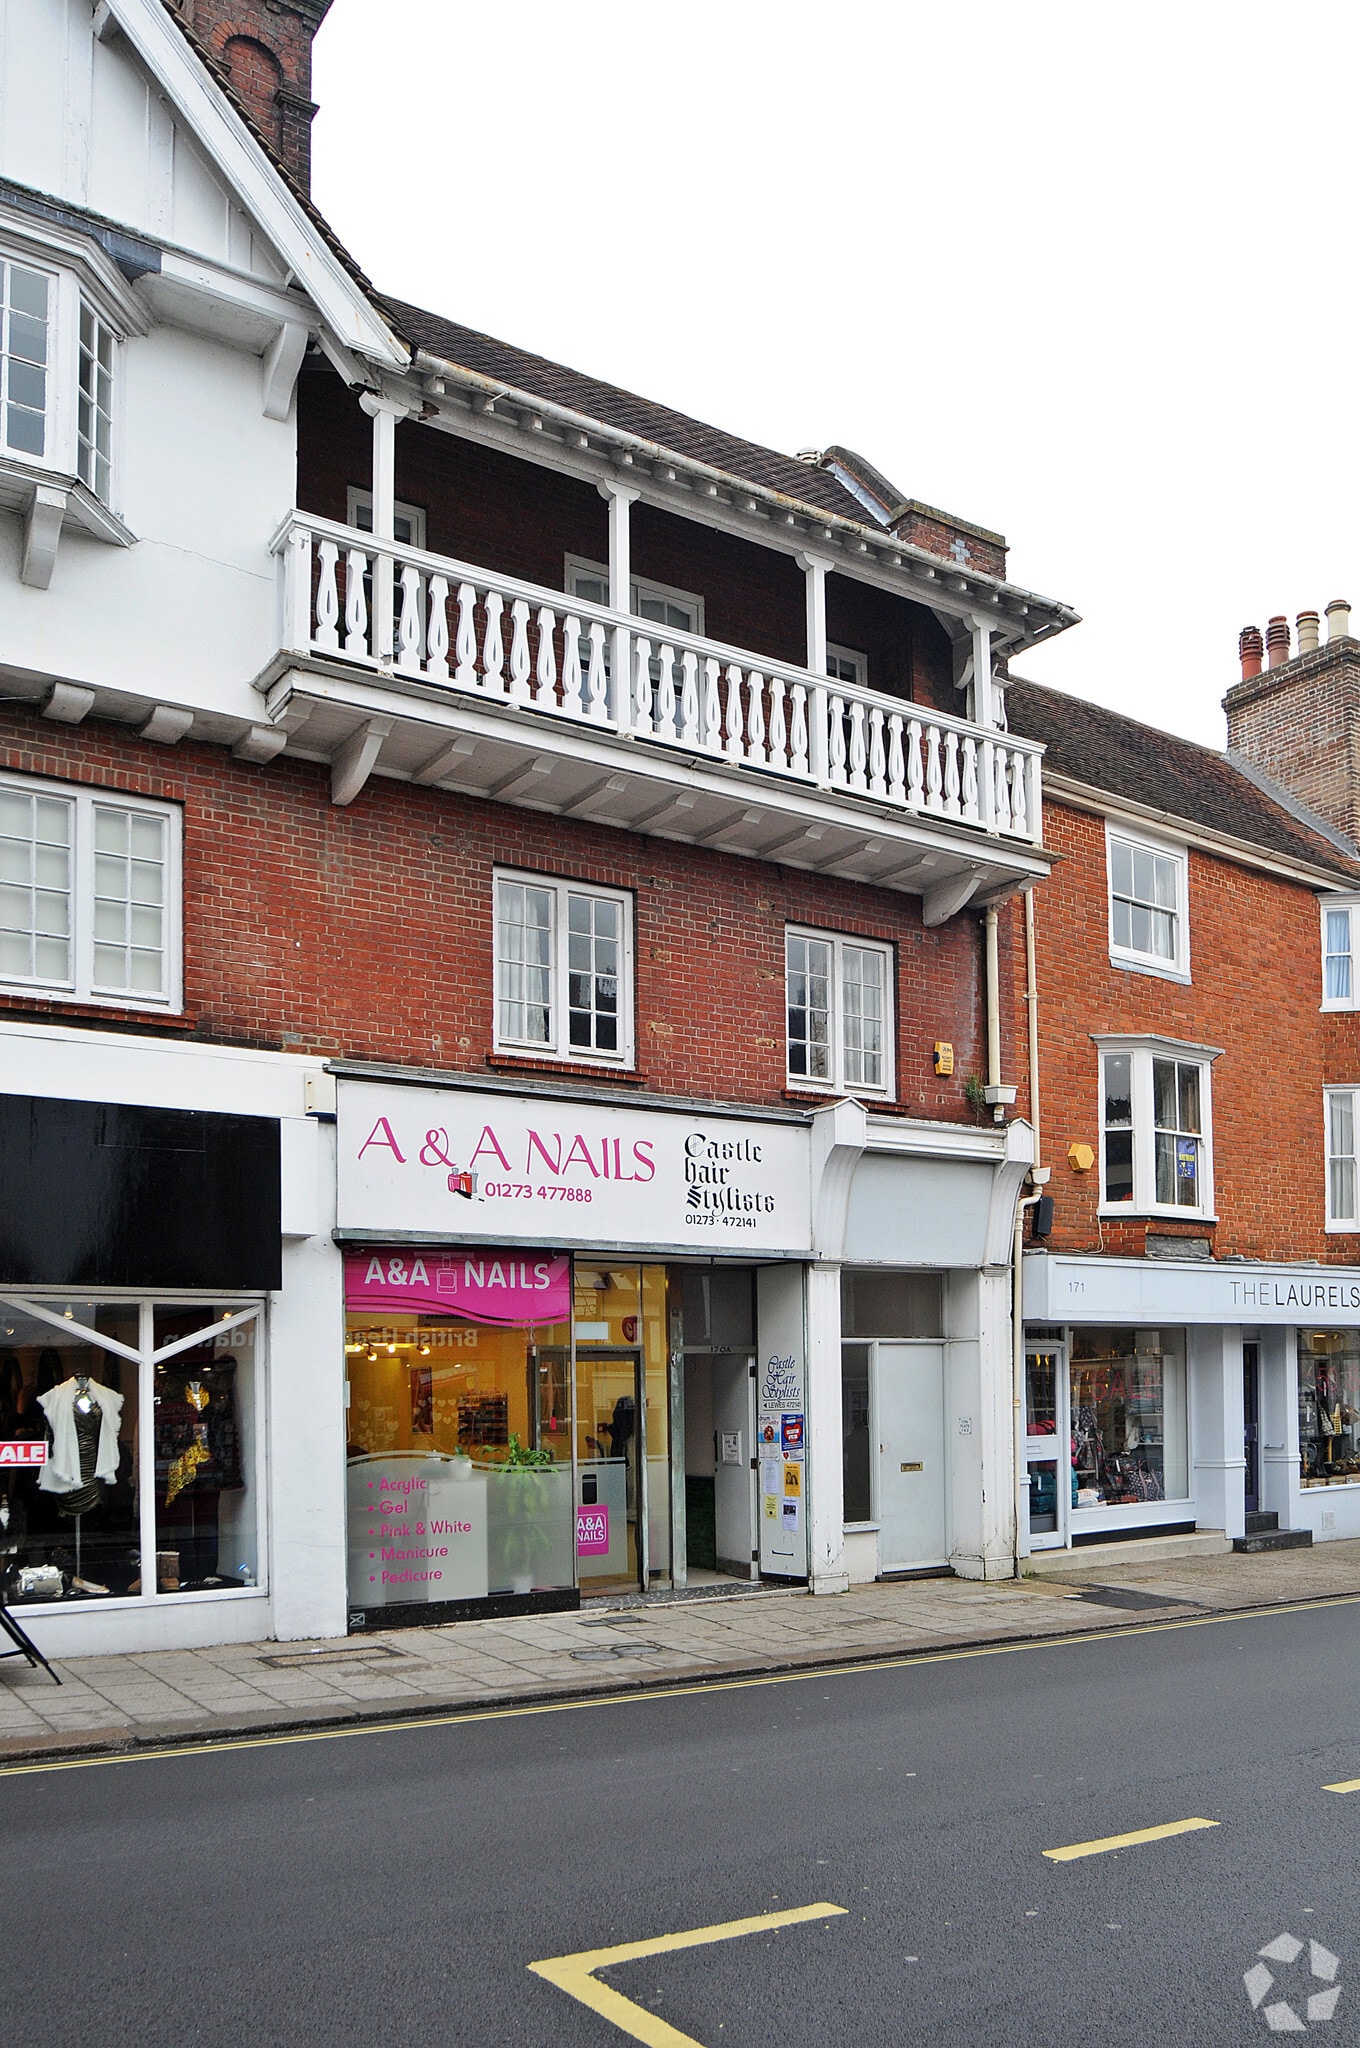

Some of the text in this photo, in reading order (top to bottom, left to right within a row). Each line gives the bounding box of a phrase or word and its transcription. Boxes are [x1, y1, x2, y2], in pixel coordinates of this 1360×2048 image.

[358, 1116, 656, 1183] A & A NAILS
[684, 1133, 762, 1163] Castle
[485, 1182, 592, 1204] 01273 477888
[686, 1185, 775, 1217] Stylists
[685, 1214, 757, 1228] 01273 472141
[364, 1256, 550, 1290] A&A NAILS
[1068, 1281, 1085, 1293] 171
[767, 1355, 796, 1374] Castle
[766, 1369, 797, 1385] Hair
[1090, 1369, 1159, 1400] SALE
[762, 1384, 801, 1402] Stylists
[379, 1476, 427, 1495] Acrylic
[379, 1500, 408, 1515] Gel
[381, 1520, 472, 1538] Pink & White
[577, 1516, 604, 1531] A&A
[577, 1530, 604, 1542] NAILS
[381, 1546, 449, 1561] Manicure
[381, 1569, 443, 1585] Pedicure
